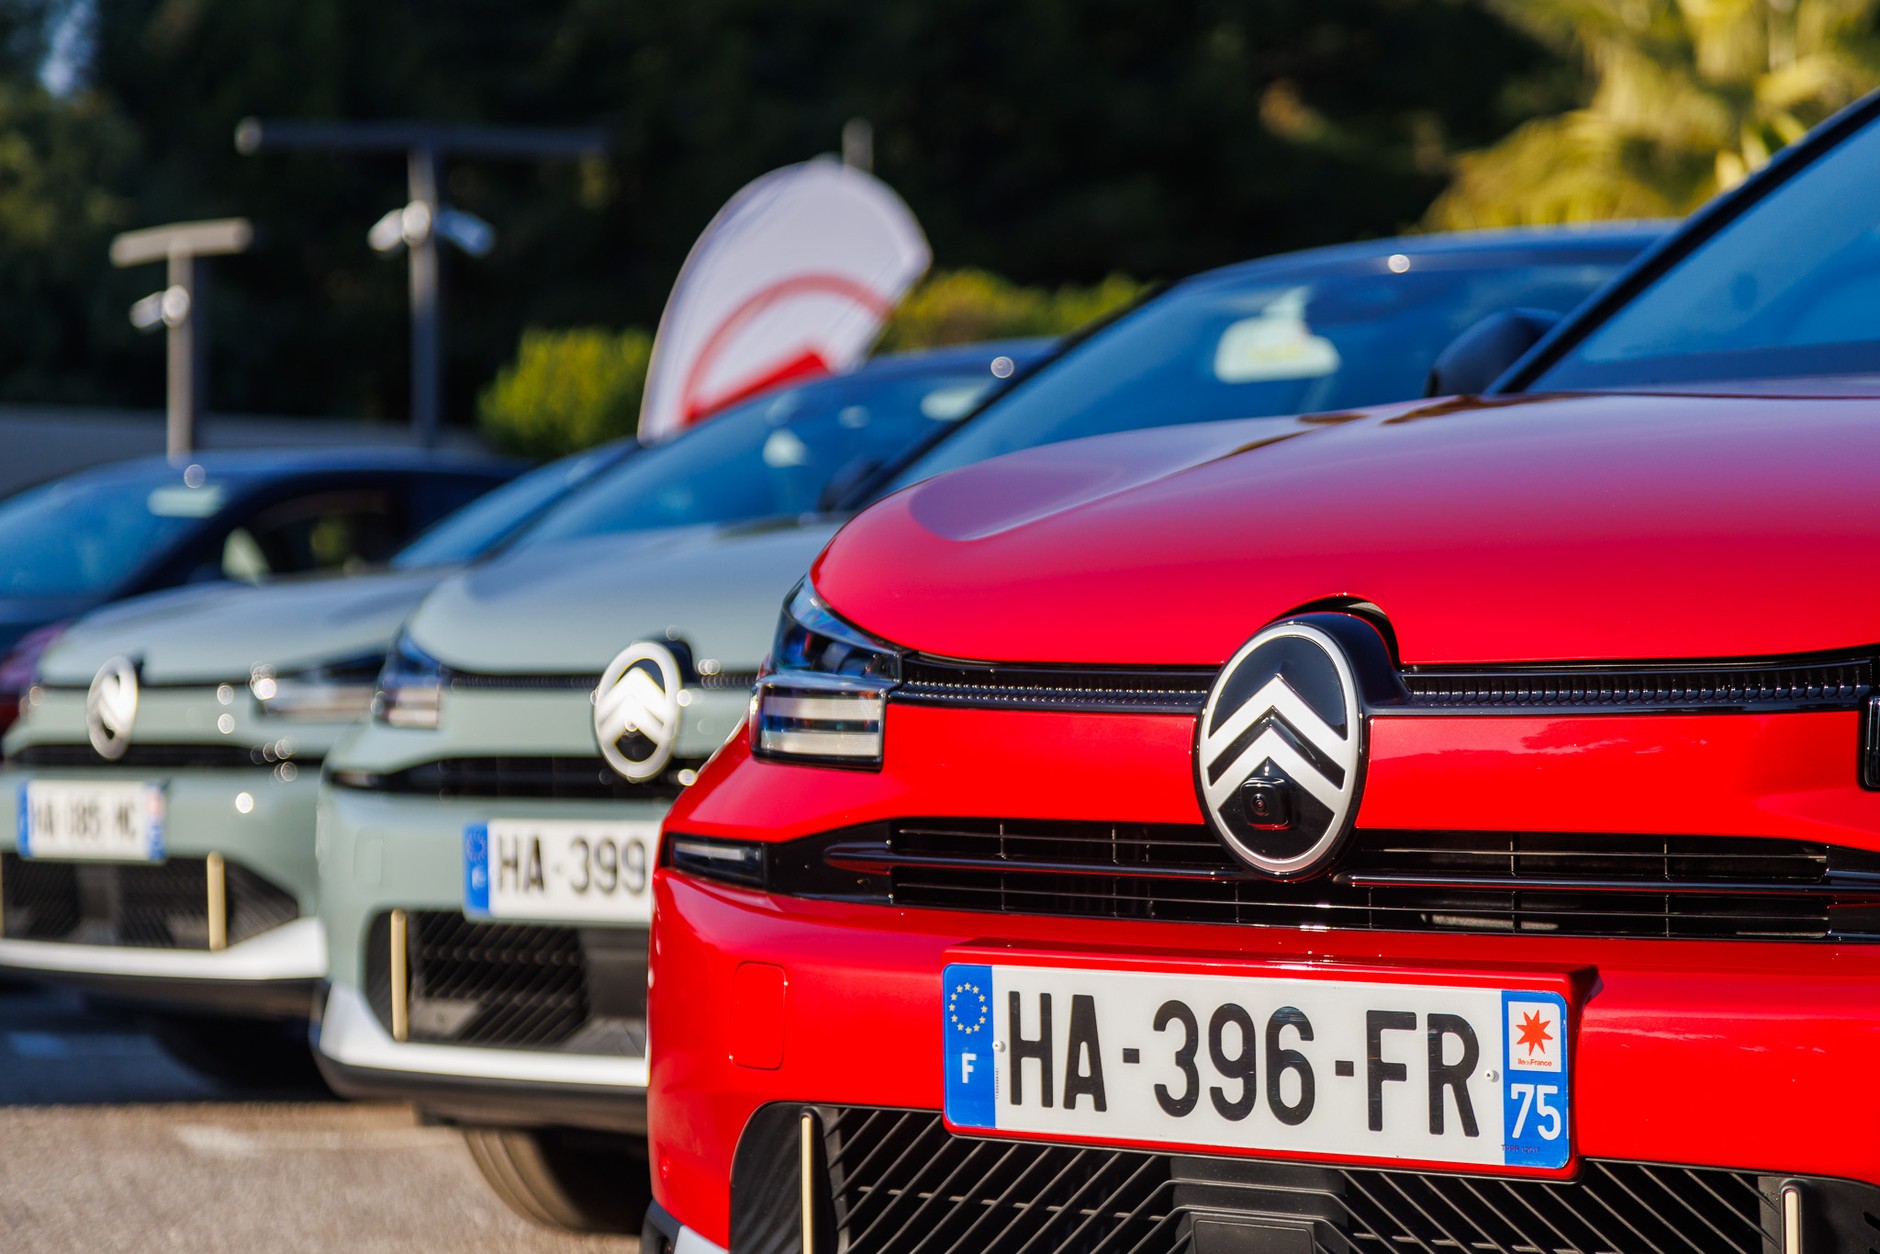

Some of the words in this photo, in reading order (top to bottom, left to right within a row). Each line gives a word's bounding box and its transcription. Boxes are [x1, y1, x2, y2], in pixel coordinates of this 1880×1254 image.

[962, 1053, 977, 1084] F
[1009, 991, 1480, 1138] HA-396-FR
[1510, 1083, 1561, 1141] 75
